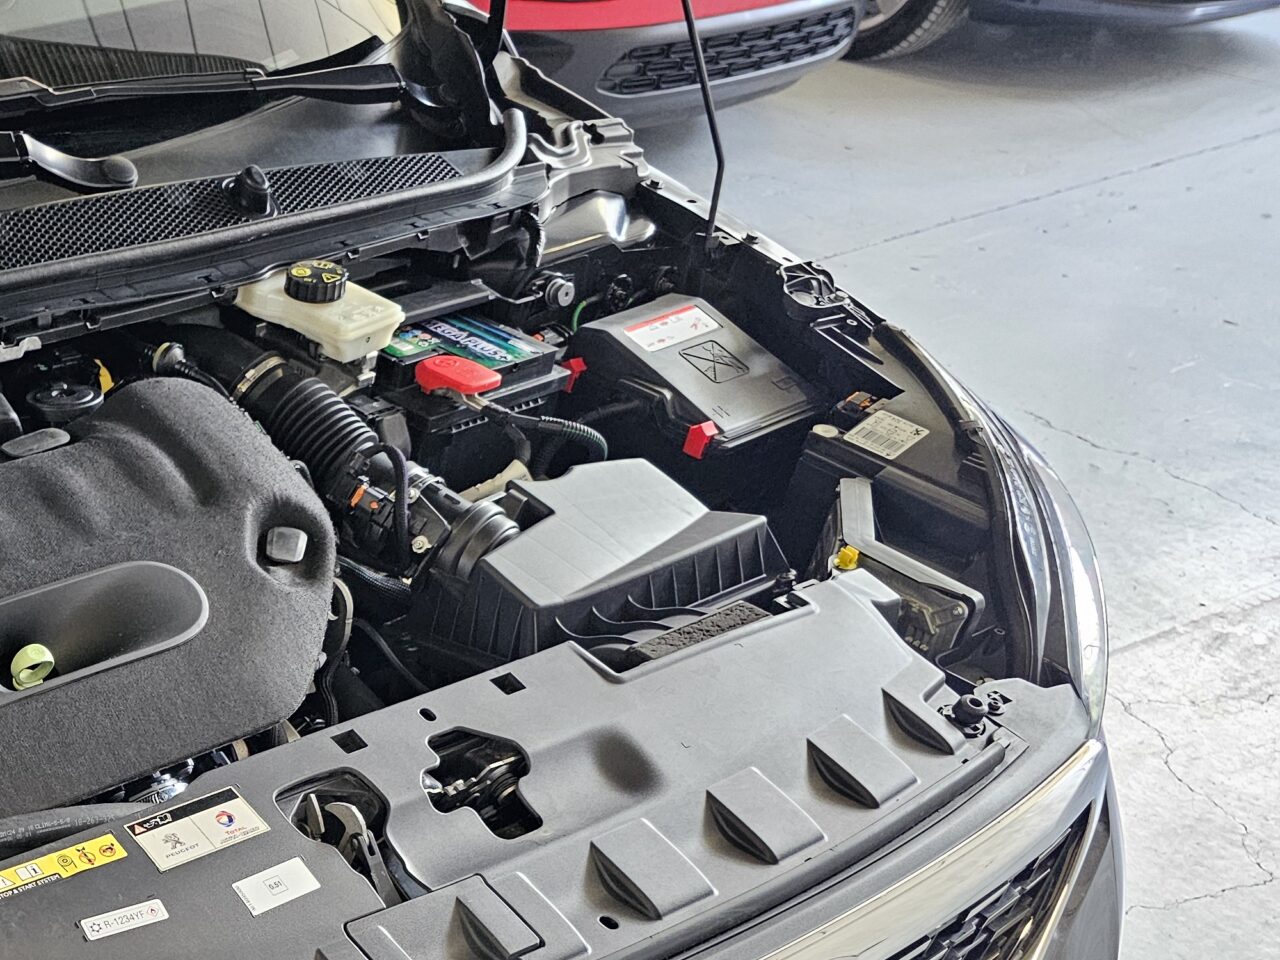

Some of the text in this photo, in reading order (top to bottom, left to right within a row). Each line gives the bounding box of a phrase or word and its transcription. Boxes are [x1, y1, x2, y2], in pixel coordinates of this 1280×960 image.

[165, 842, 199, 859] PEUGEOT
[19, 881, 37, 893] START
[37, 874, 61, 887] SYSTEM
[103, 910, 145, 929] R-1234YF
